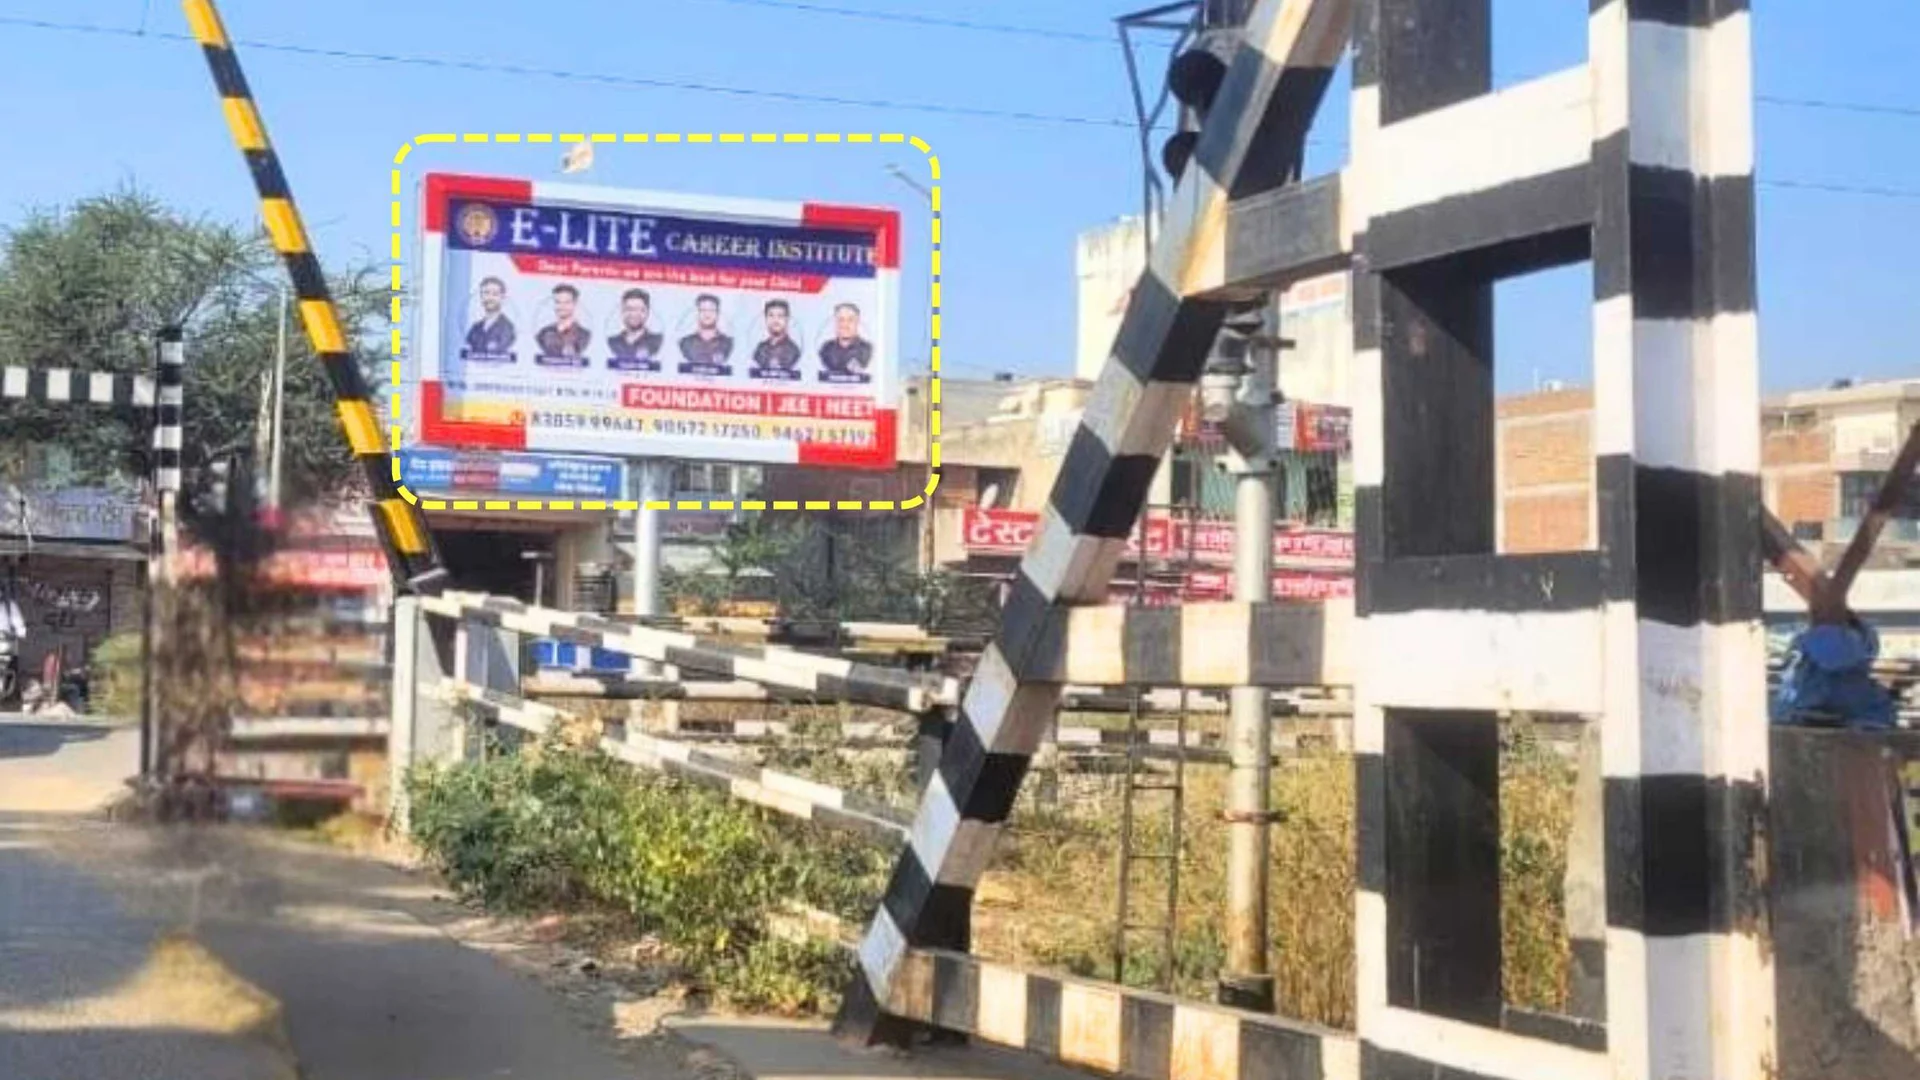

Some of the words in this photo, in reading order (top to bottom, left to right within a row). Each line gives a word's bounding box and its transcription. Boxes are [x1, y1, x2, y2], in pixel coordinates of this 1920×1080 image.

[510, 207, 658, 256] E-LITE
[664, 231, 761, 258] CAREER
[767, 238, 878, 266] INSTITUTE
[628, 387, 762, 413] FOUNDATION
